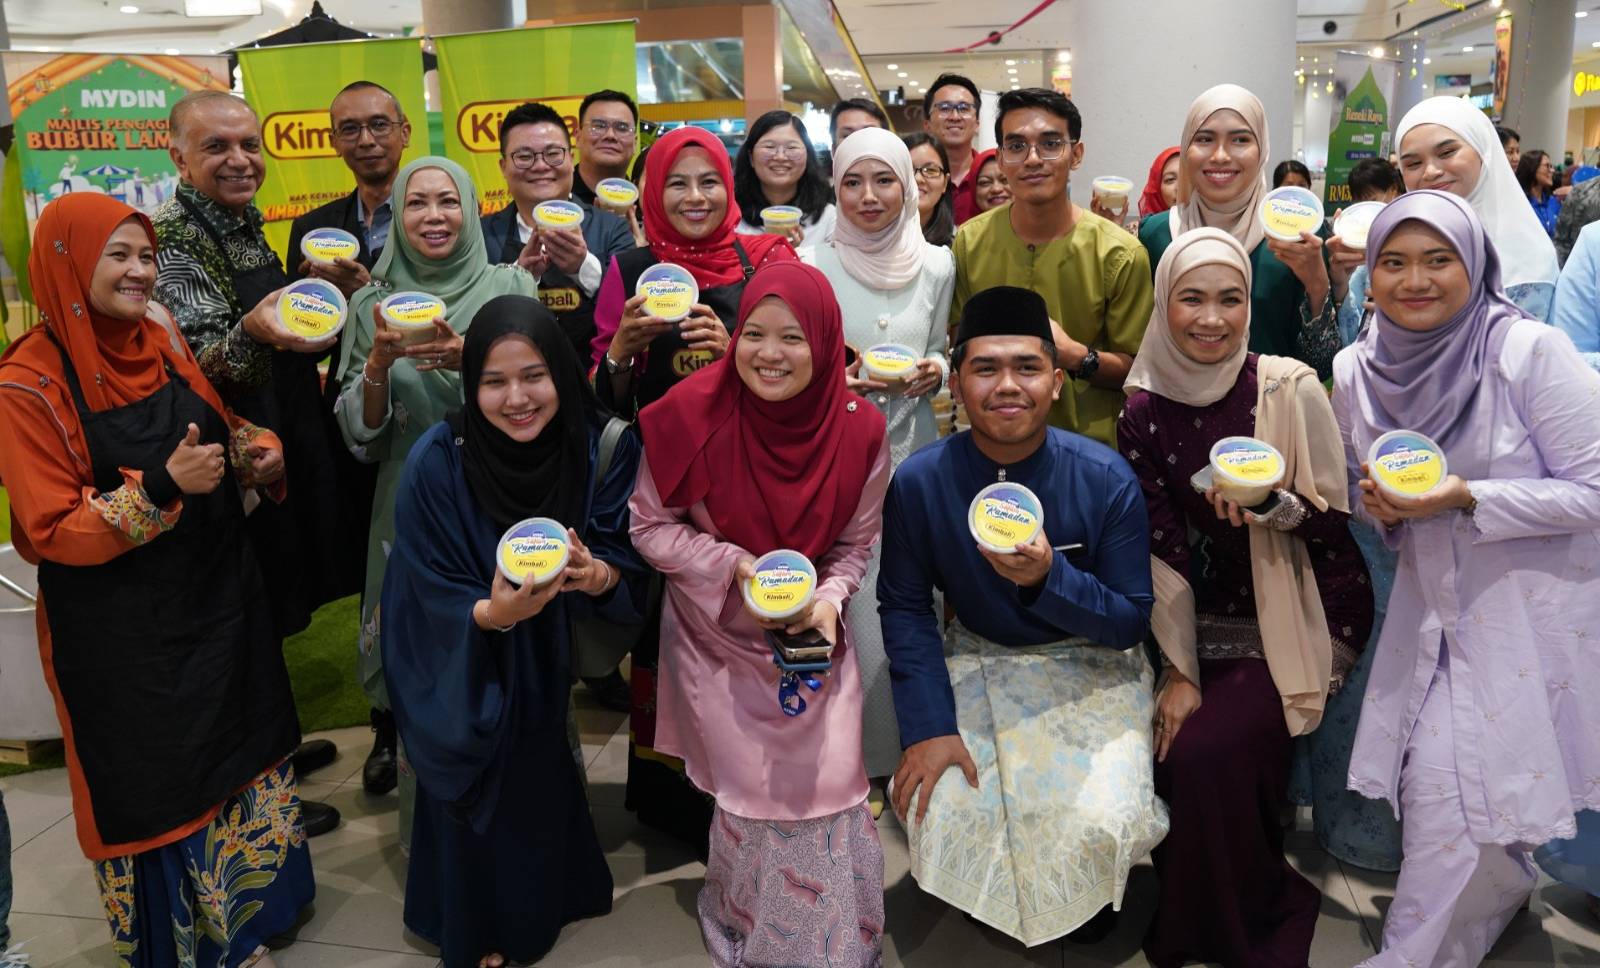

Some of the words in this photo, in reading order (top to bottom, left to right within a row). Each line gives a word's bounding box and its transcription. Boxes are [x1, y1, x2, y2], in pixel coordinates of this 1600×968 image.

[81, 89, 166, 108] MYDIN
[47, 119, 102, 131] MAJLIS
[26, 132, 118, 150] BUBUR
[646, 286, 687, 295] Ramadan
[291, 297, 334, 315] Ramadan
[1382, 455, 1430, 470] Ramadan
[986, 504, 1030, 524] Ramadan
[512, 543, 559, 554] Ramadan
[758, 575, 804, 586] Ramadan
